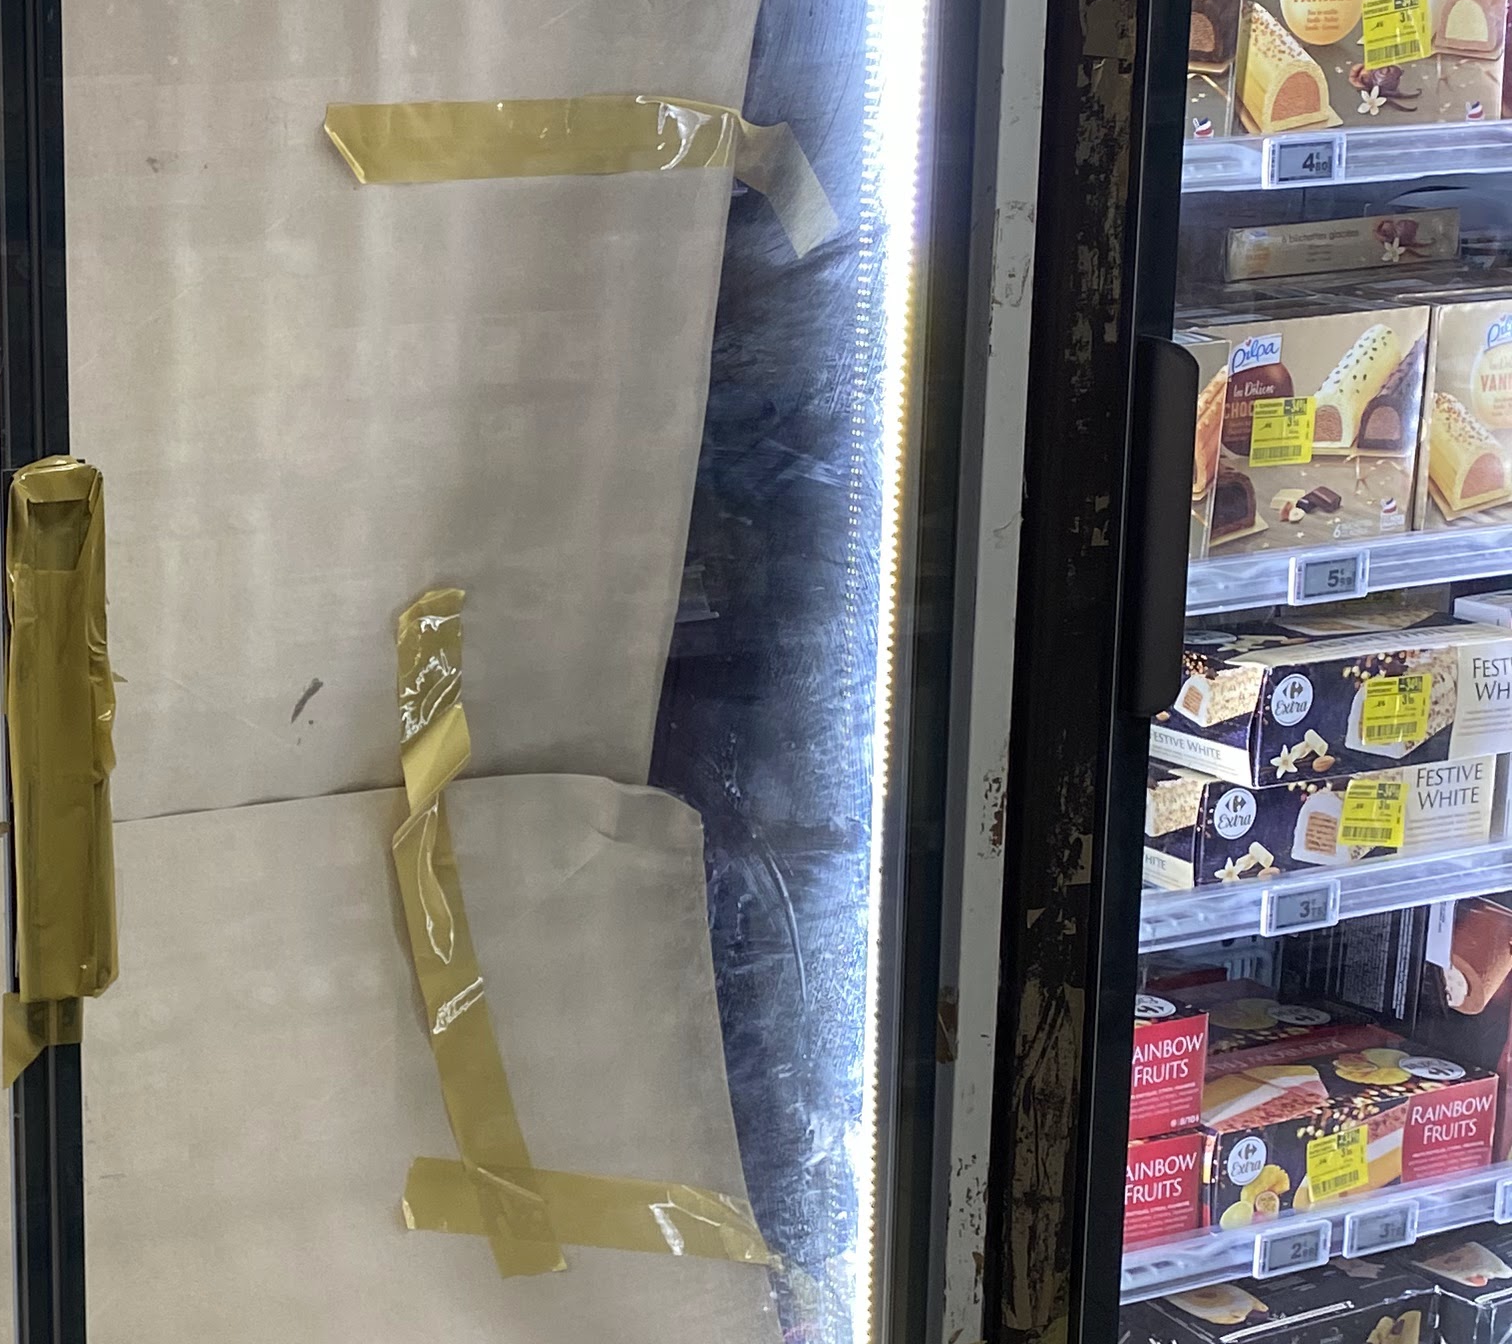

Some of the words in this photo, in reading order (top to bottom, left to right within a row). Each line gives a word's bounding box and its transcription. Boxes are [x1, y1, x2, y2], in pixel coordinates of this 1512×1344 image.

[1472, 657, 1512, 679] FEST
[1274, 698, 1309, 718] Extra
[1153, 731, 1185, 750] ESTIVE
[1187, 739, 1222, 760] WHITE
[1415, 762, 1484, 788] FESTIVE
[1417, 786, 1480, 810] WHITE
[1218, 812, 1254, 831] Extra
[1144, 853, 1167, 871] HITE
[1131, 1032, 1204, 1065] AINBOW
[1133, 1058, 1189, 1088] FRUITS
[1410, 1094, 1494, 1126] RAINBOW
[1422, 1118, 1478, 1146] FRUITS
[1125, 1151, 1198, 1183] AINBOW
[1230, 1158, 1262, 1177] Extra
[1124, 1177, 1183, 1206] FRUITS
